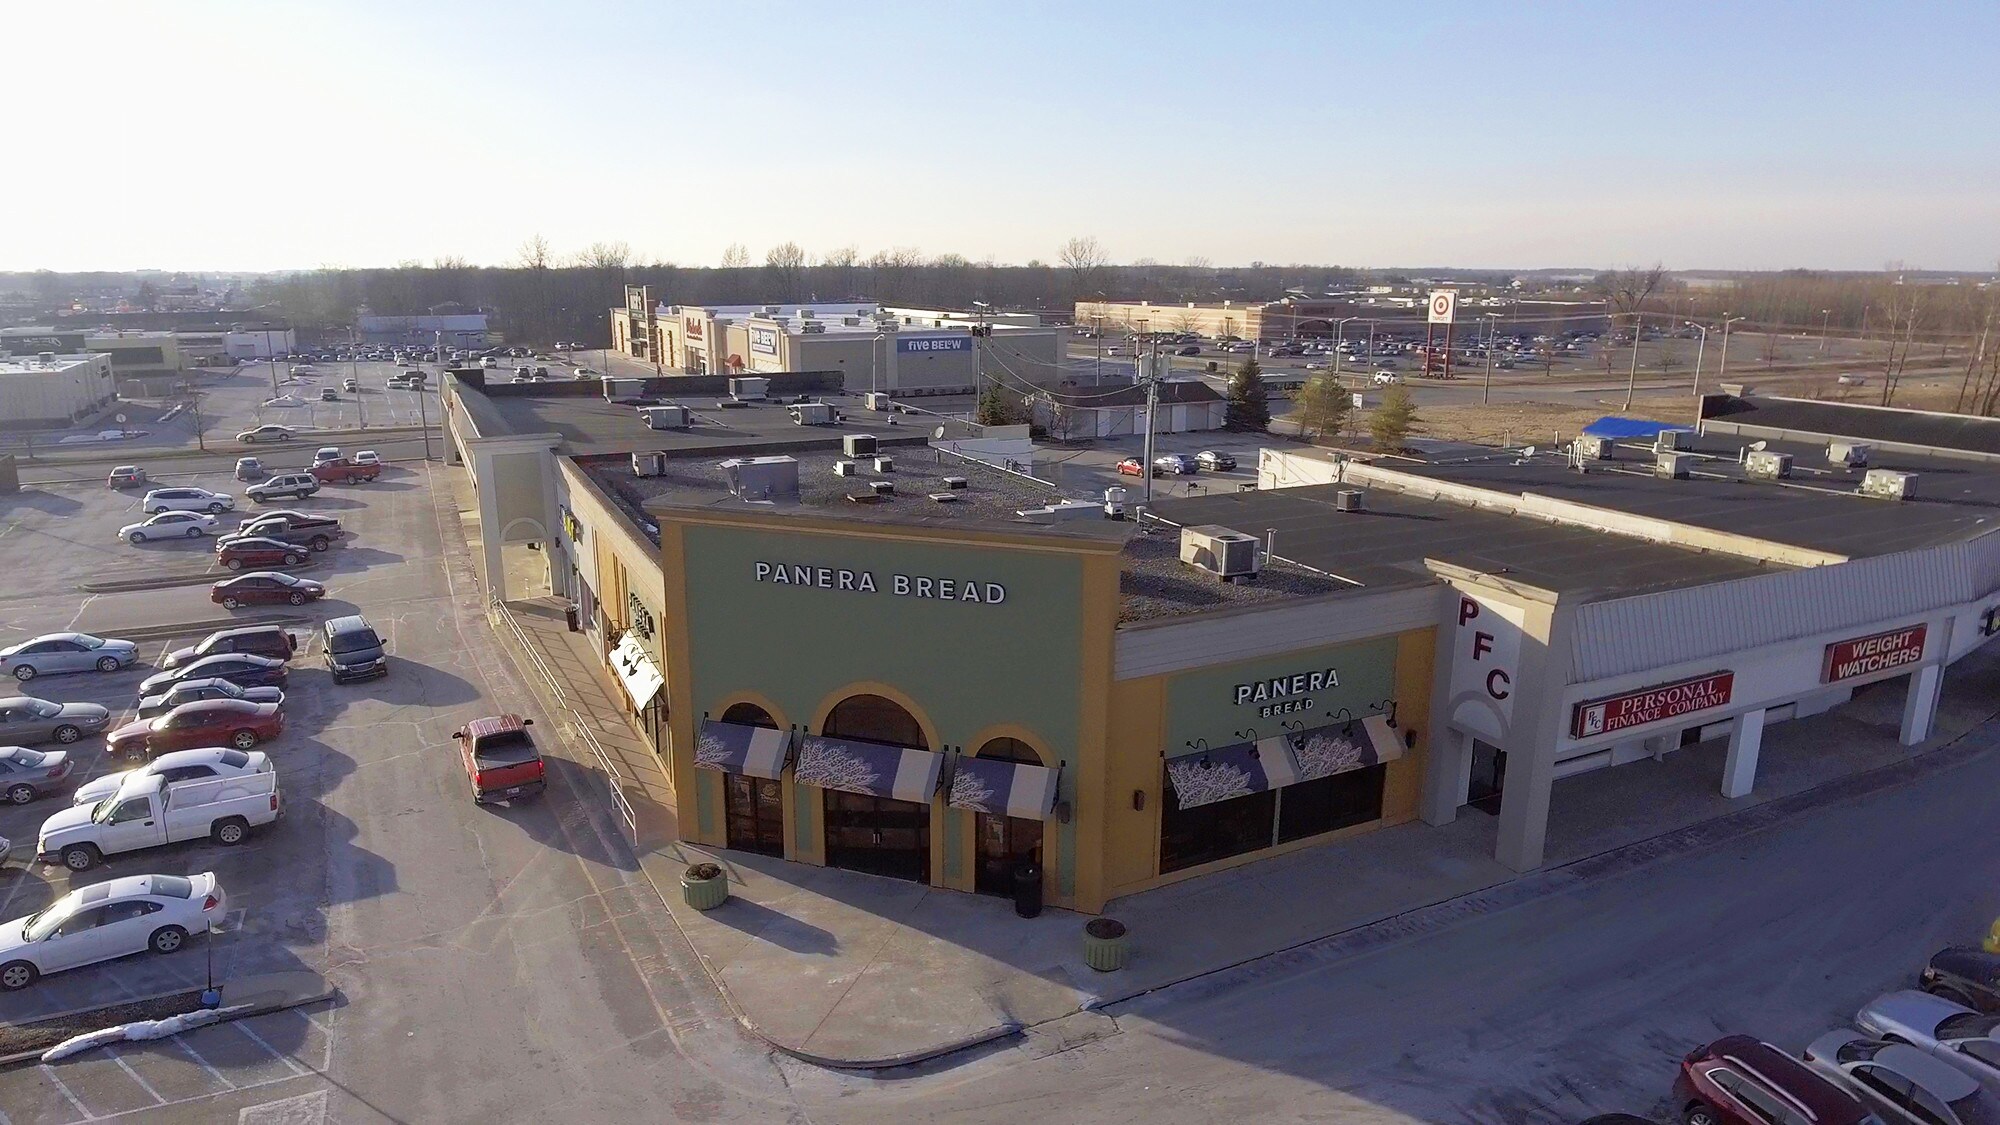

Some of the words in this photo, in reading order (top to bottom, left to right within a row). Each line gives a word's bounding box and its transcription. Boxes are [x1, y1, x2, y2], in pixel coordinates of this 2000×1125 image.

[908, 340, 929, 351] five
[755, 561, 878, 593] PANERA
[893, 573, 1006, 604] BREAD
[1852, 630, 1914, 659] WEIGHT
[1838, 646, 1921, 679] WATCHERS
[1234, 668, 1340, 705] PANERA
[1619, 680, 1718, 715] PERSONAL
[1260, 698, 1314, 719] BREAD
[1606, 707, 1662, 731] FINANCE
[1668, 691, 1726, 716] COMPANY
